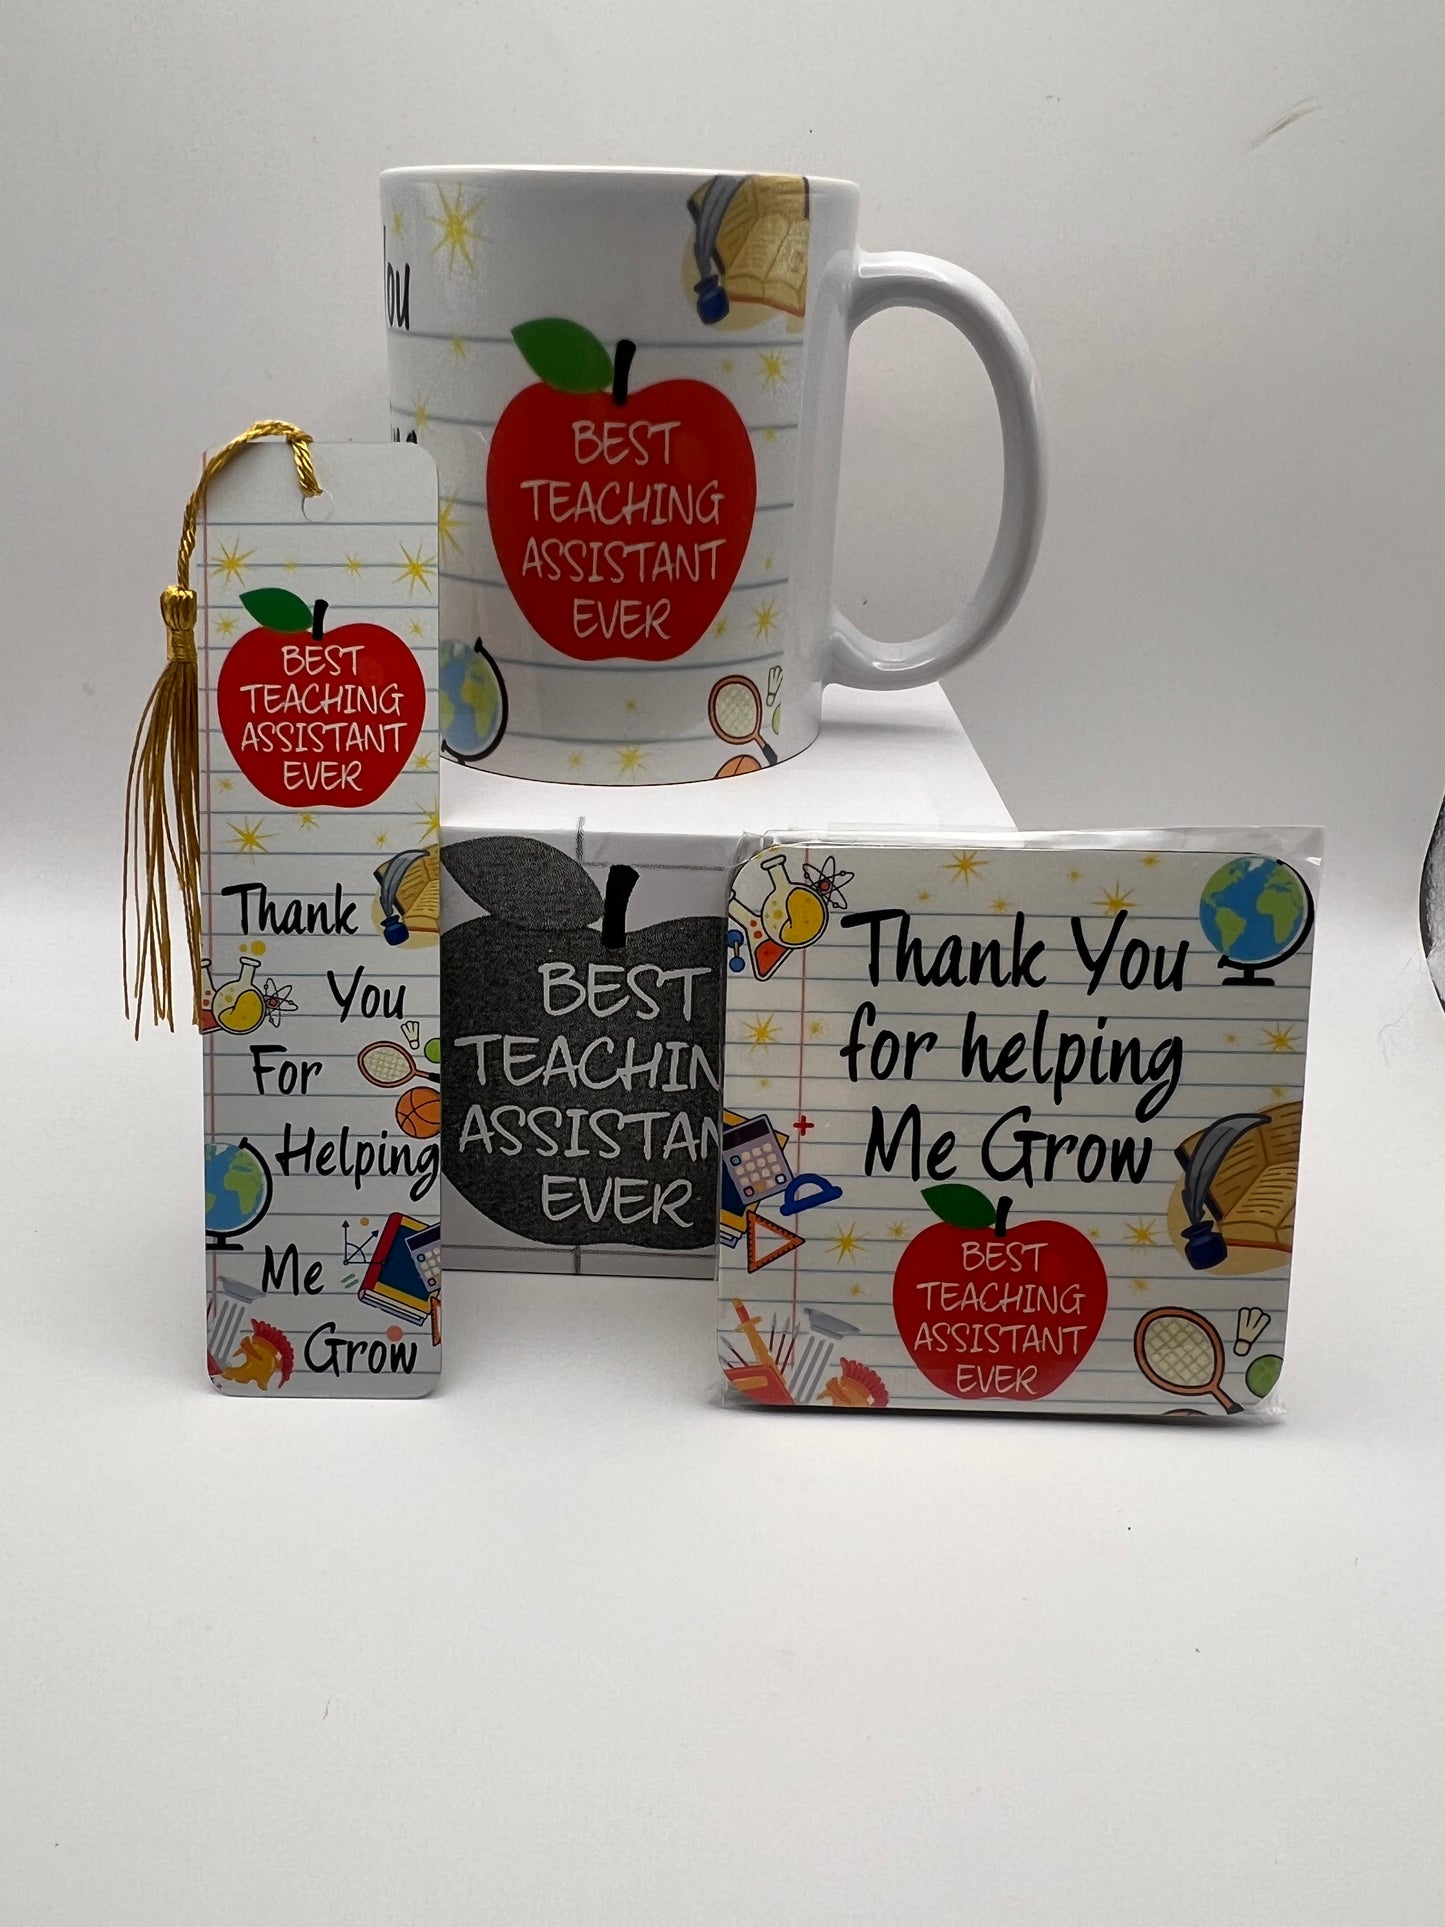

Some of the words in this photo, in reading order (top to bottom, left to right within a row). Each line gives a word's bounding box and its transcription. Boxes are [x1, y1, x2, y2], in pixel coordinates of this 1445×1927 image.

[571, 420, 682, 466] BEST
[519, 478, 727, 527] TEACHING
[521, 538, 727, 584] ASSISTANT
[572, 597, 672, 641] EVER
[281, 645, 366, 676] BEST
[239, 683, 405, 716] TEACHING
[241, 721, 409, 753] ASSISTANT
[283, 760, 363, 792] EVER
[221, 882, 360, 936] Thank
[840, 908, 1047, 989] Thank
[1070, 909, 1190, 996] You
[326, 965, 406, 1024] You
[538, 962, 712, 1021] BEST
[249, 1044, 323, 1096] For
[839, 1000, 938, 1082] for
[961, 1008, 1184, 1123] helping
[275, 1122, 440, 1202] Helping
[864, 1103, 958, 1182] Me
[980, 1104, 1153, 1188] Grow
[541, 1174, 694, 1228] EVER
[261, 1243, 325, 1296] Me
[961, 1241, 1049, 1273] BEST
[916, 1281, 1087, 1316] TEACHING
[303, 1321, 419, 1376] Grow
[913, 1321, 1088, 1354] ASSISTANT
[955, 1363, 1038, 1396] EVER
